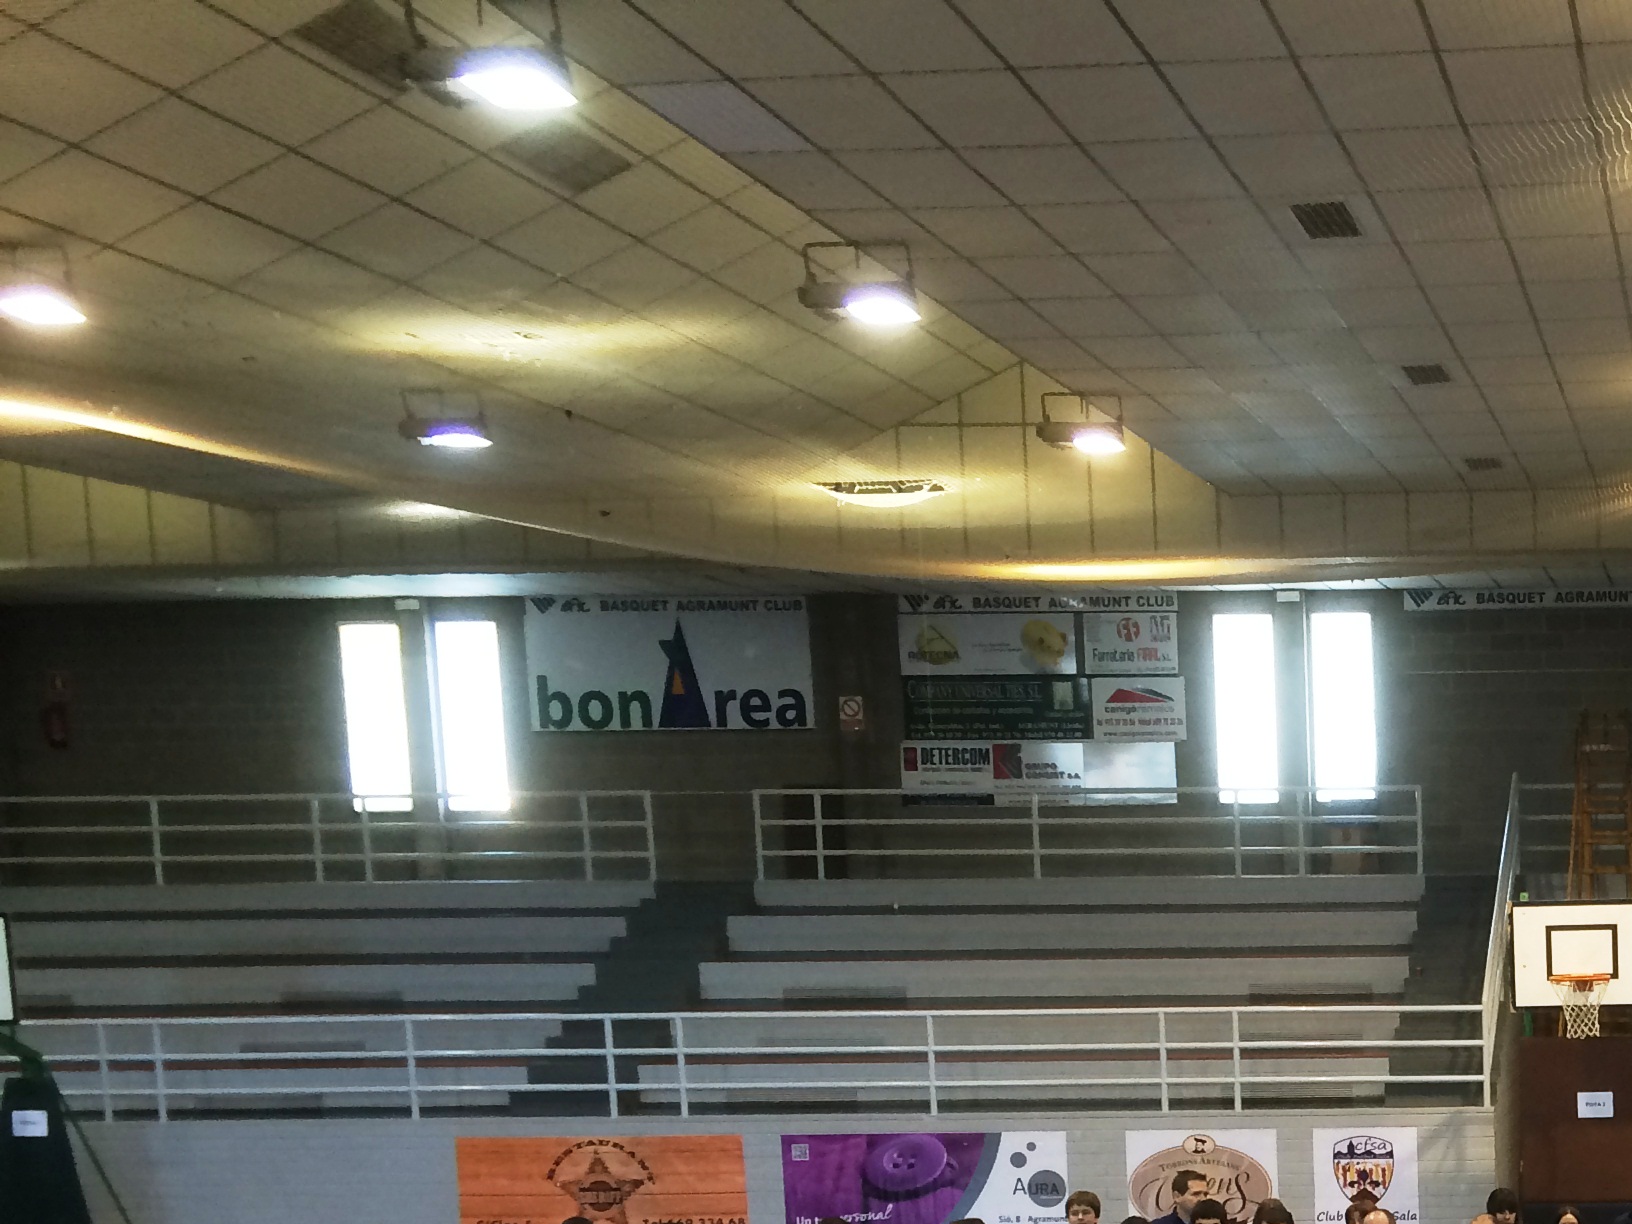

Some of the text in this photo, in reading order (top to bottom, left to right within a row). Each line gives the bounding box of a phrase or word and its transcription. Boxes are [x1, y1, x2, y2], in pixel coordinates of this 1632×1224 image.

[973, 595, 1175, 609] BASQUET AGAMUNT CLUB
[1475, 592, 1546, 604] BASQUET
[600, 599, 803, 612] BASQUET AGRAMUNT CLUB
[921, 747, 990, 766] DETERCOM
[1354, 1137, 1387, 1151] cfsa
[1013, 1177, 1060, 1195] AURA
[1316, 1210, 1344, 1222] Club
